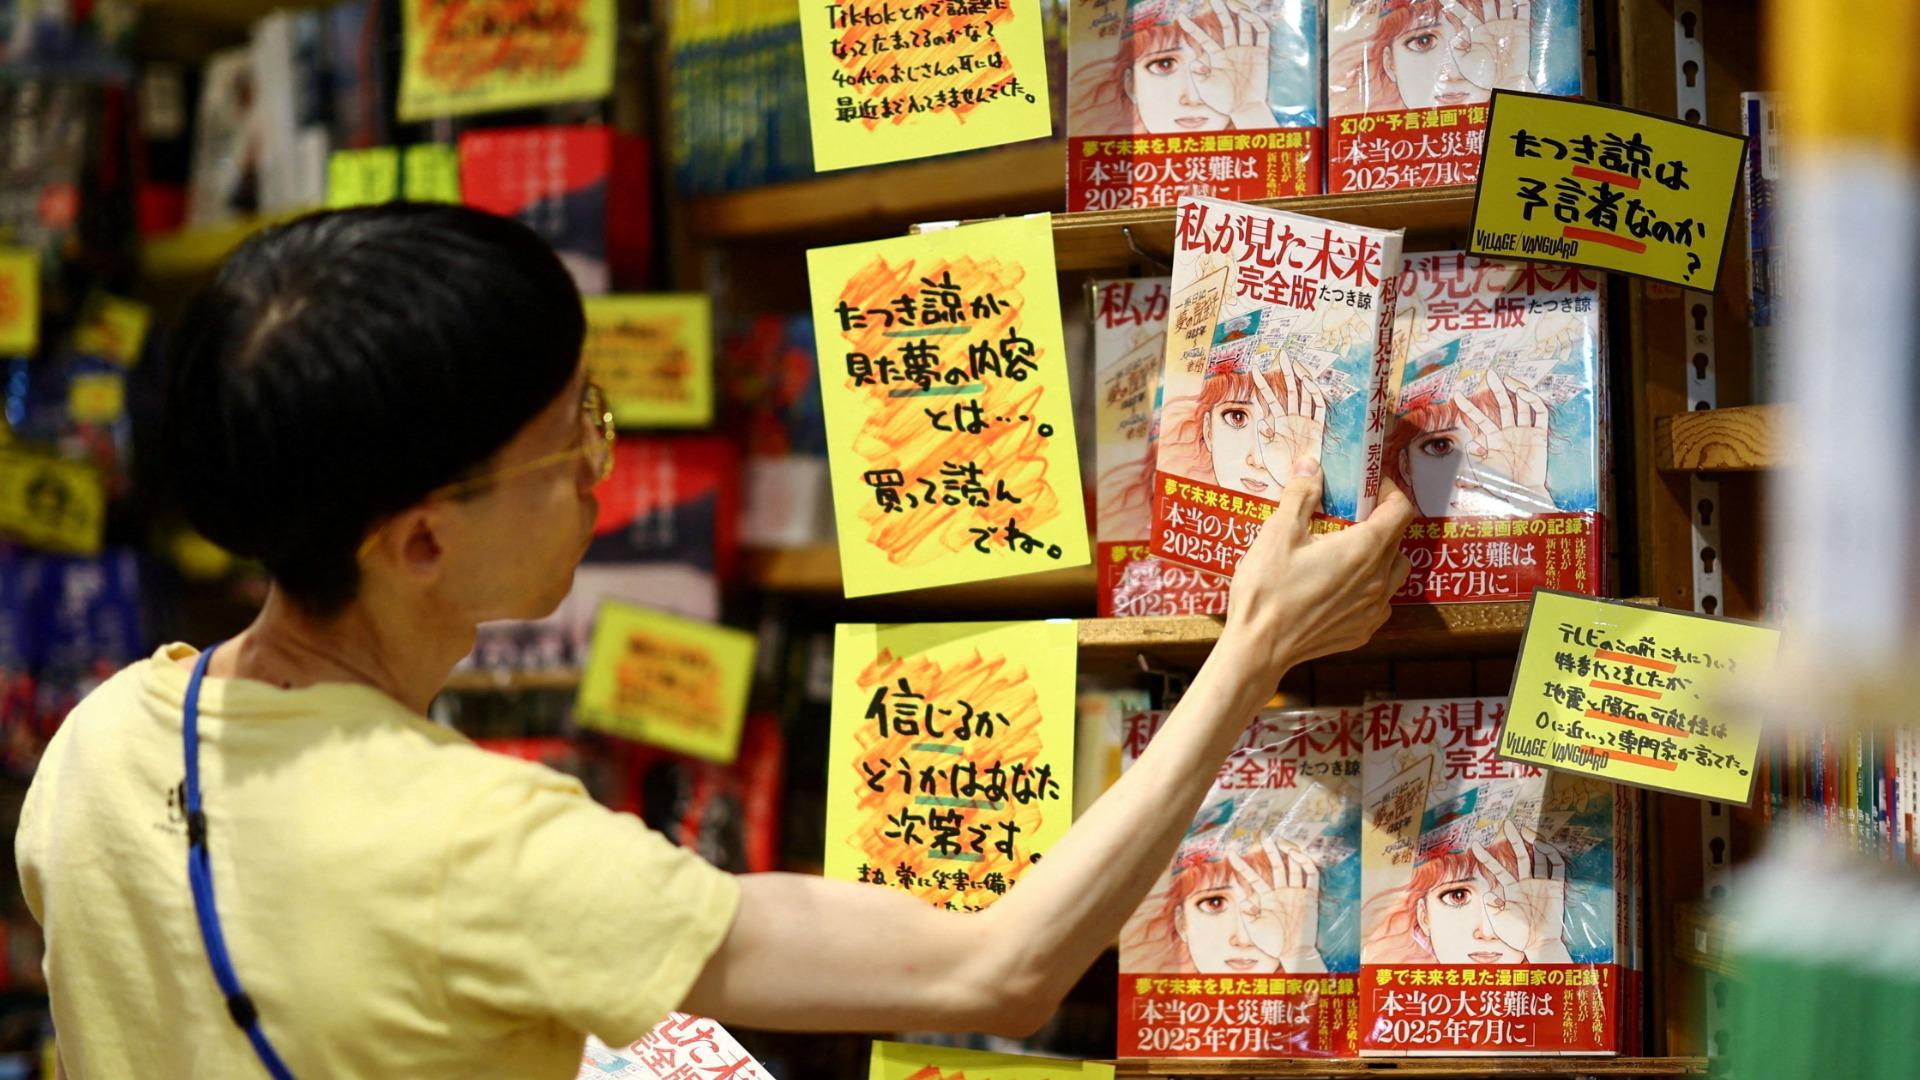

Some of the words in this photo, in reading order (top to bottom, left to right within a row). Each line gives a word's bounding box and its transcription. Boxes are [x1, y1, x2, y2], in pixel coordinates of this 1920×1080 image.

[832, 51, 1003, 88] 40代のおじさんの耳には
[1340, 106, 1490, 136] 幻の“予言漫画”復
[1082, 131, 1312, 157] 夢で未来を見た漫画家の記録！
[1080, 157, 1259, 186] 「本当の大災難は
[1510, 129, 1690, 190] たつき諒は
[1516, 177, 1706, 247] 予言者なのか
[1175, 201, 1382, 288] 私が見た未来
[1236, 265, 1320, 313] 完全版
[1319, 284, 1373, 311] たつき諒
[1427, 298, 1526, 332] 完全版
[1528, 297, 1593, 315] たつき諒
[846, 327, 1039, 392] 見た夢の内容
[1364, 442, 1382, 499] 完全版
[864, 461, 1022, 513] 買って読ん
[1164, 478, 1280, 521] 夢で未来を見た漫
[1402, 517, 1592, 540] 来を見た漫画家の記録！
[1402, 542, 1537, 570] の大災難は
[864, 677, 1011, 741] 信じるか
[863, 757, 1060, 804] どうかはあなた
[1300, 760, 1361, 777] たつき諒
[1136, 977, 1360, 996] 夢で未来を見た漫画家の記録！
[1375, 968, 1609, 988] 夢で未来を見た漫画家の記録！
[1132, 997, 1311, 1026] 「本当の大災難は
[1372, 988, 1555, 1018] 「本当の大災難は
[1377, 1019, 1537, 1047] 2025年7月に」
